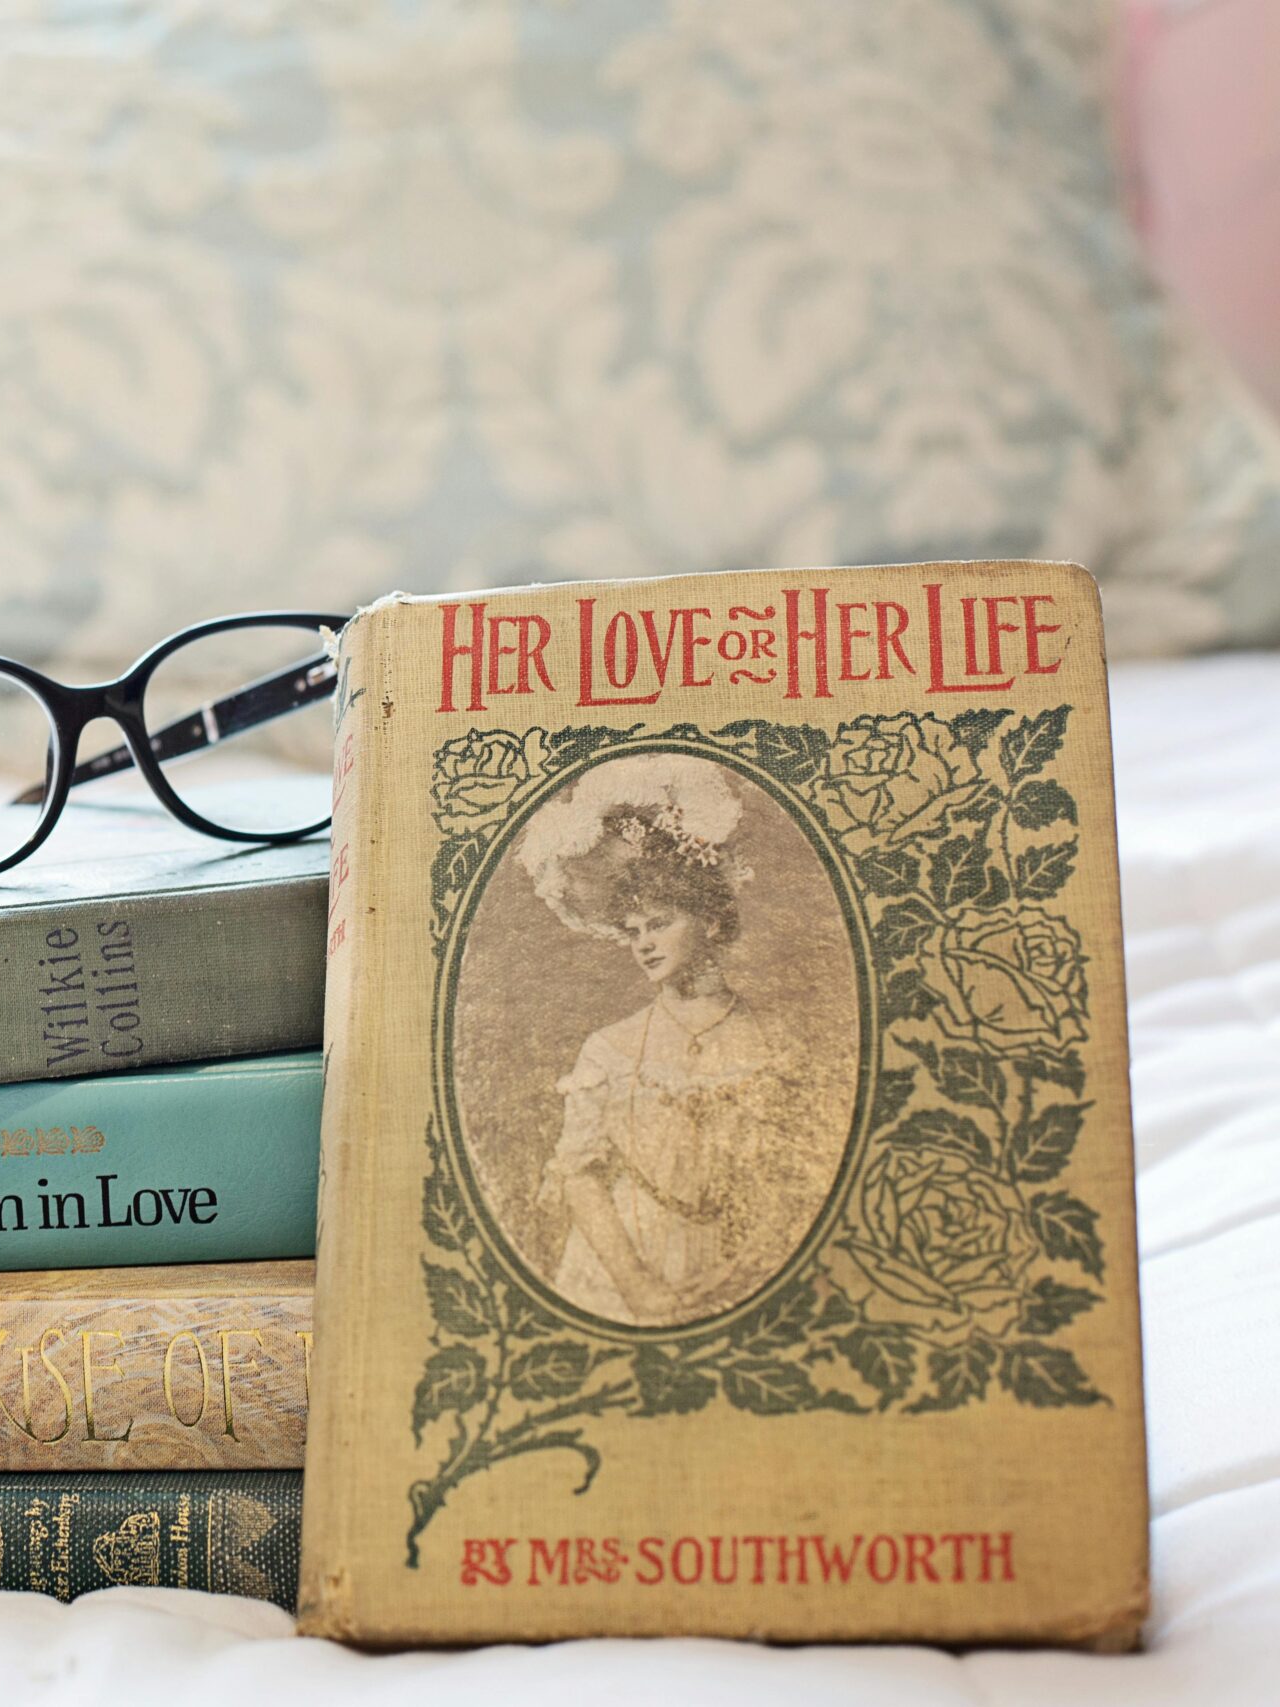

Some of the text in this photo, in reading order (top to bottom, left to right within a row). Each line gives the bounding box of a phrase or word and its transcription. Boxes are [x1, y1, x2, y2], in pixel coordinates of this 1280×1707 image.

[434, 583, 1063, 714] HER LOVE OR HER LIFE
[37, 926, 90, 1068] Wilkie
[92, 918, 145, 1059] Collins
[36, 1177, 88, 1232] in
[95, 1173, 220, 1229] Love
[163, 1327, 264, 1445] OF
[168, 1492, 192, 1590] ndom House
[460, 1538, 519, 1587] BY
[634, 1530, 1018, 1586] SOUTHWORTH
